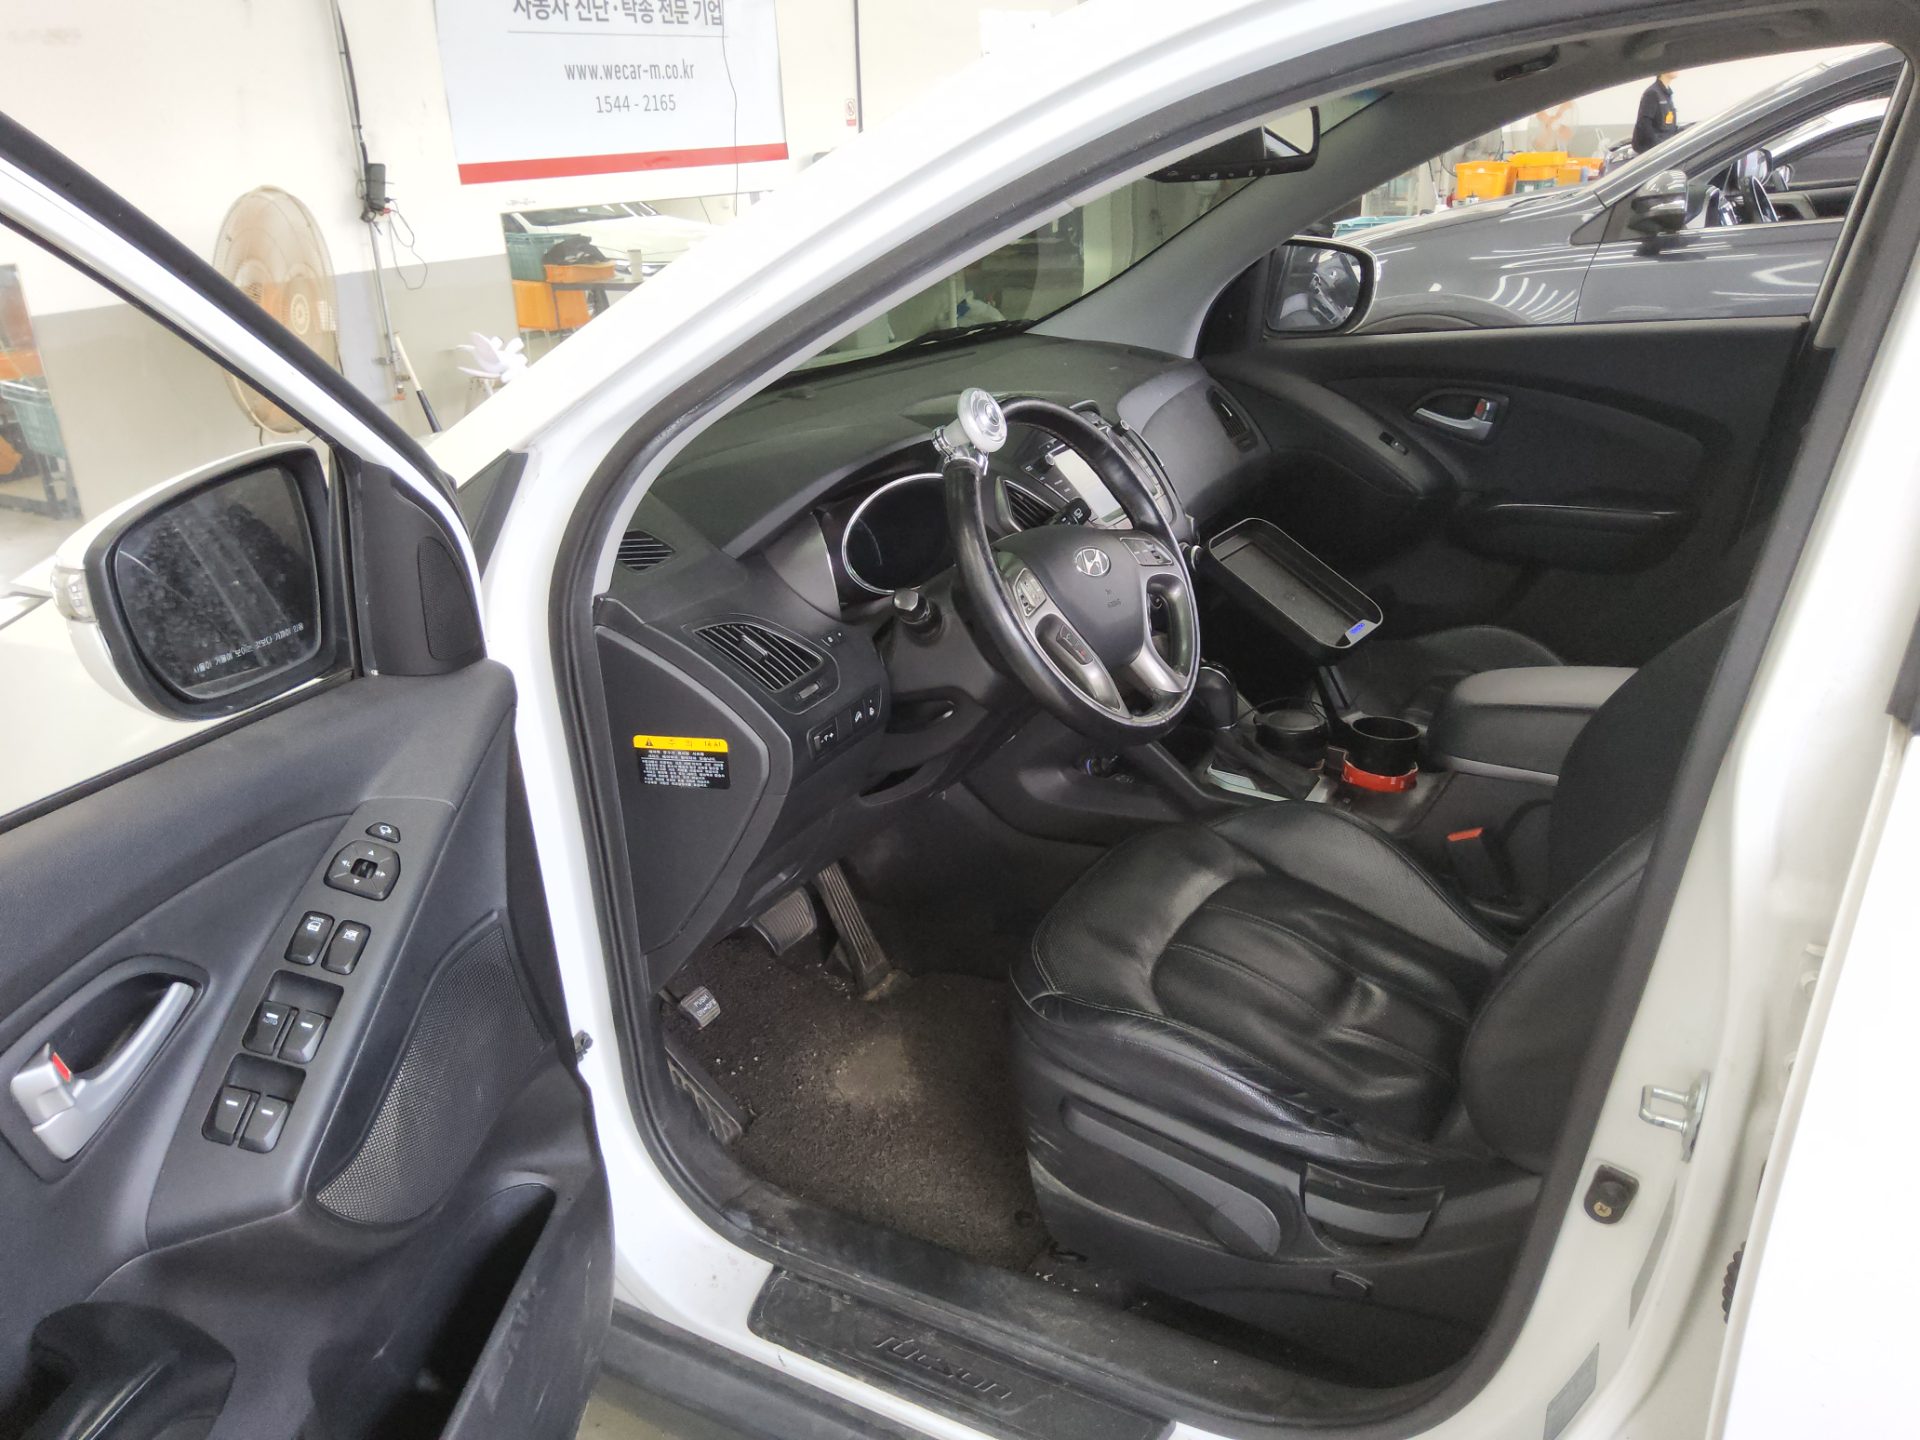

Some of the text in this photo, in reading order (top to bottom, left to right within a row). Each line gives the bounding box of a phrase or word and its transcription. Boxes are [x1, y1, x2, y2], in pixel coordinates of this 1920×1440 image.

[658, 0, 689, 25] 전문
[693, 0, 723, 26] 기업
[564, 58, 695, 80] www.wecar-m.co.kr
